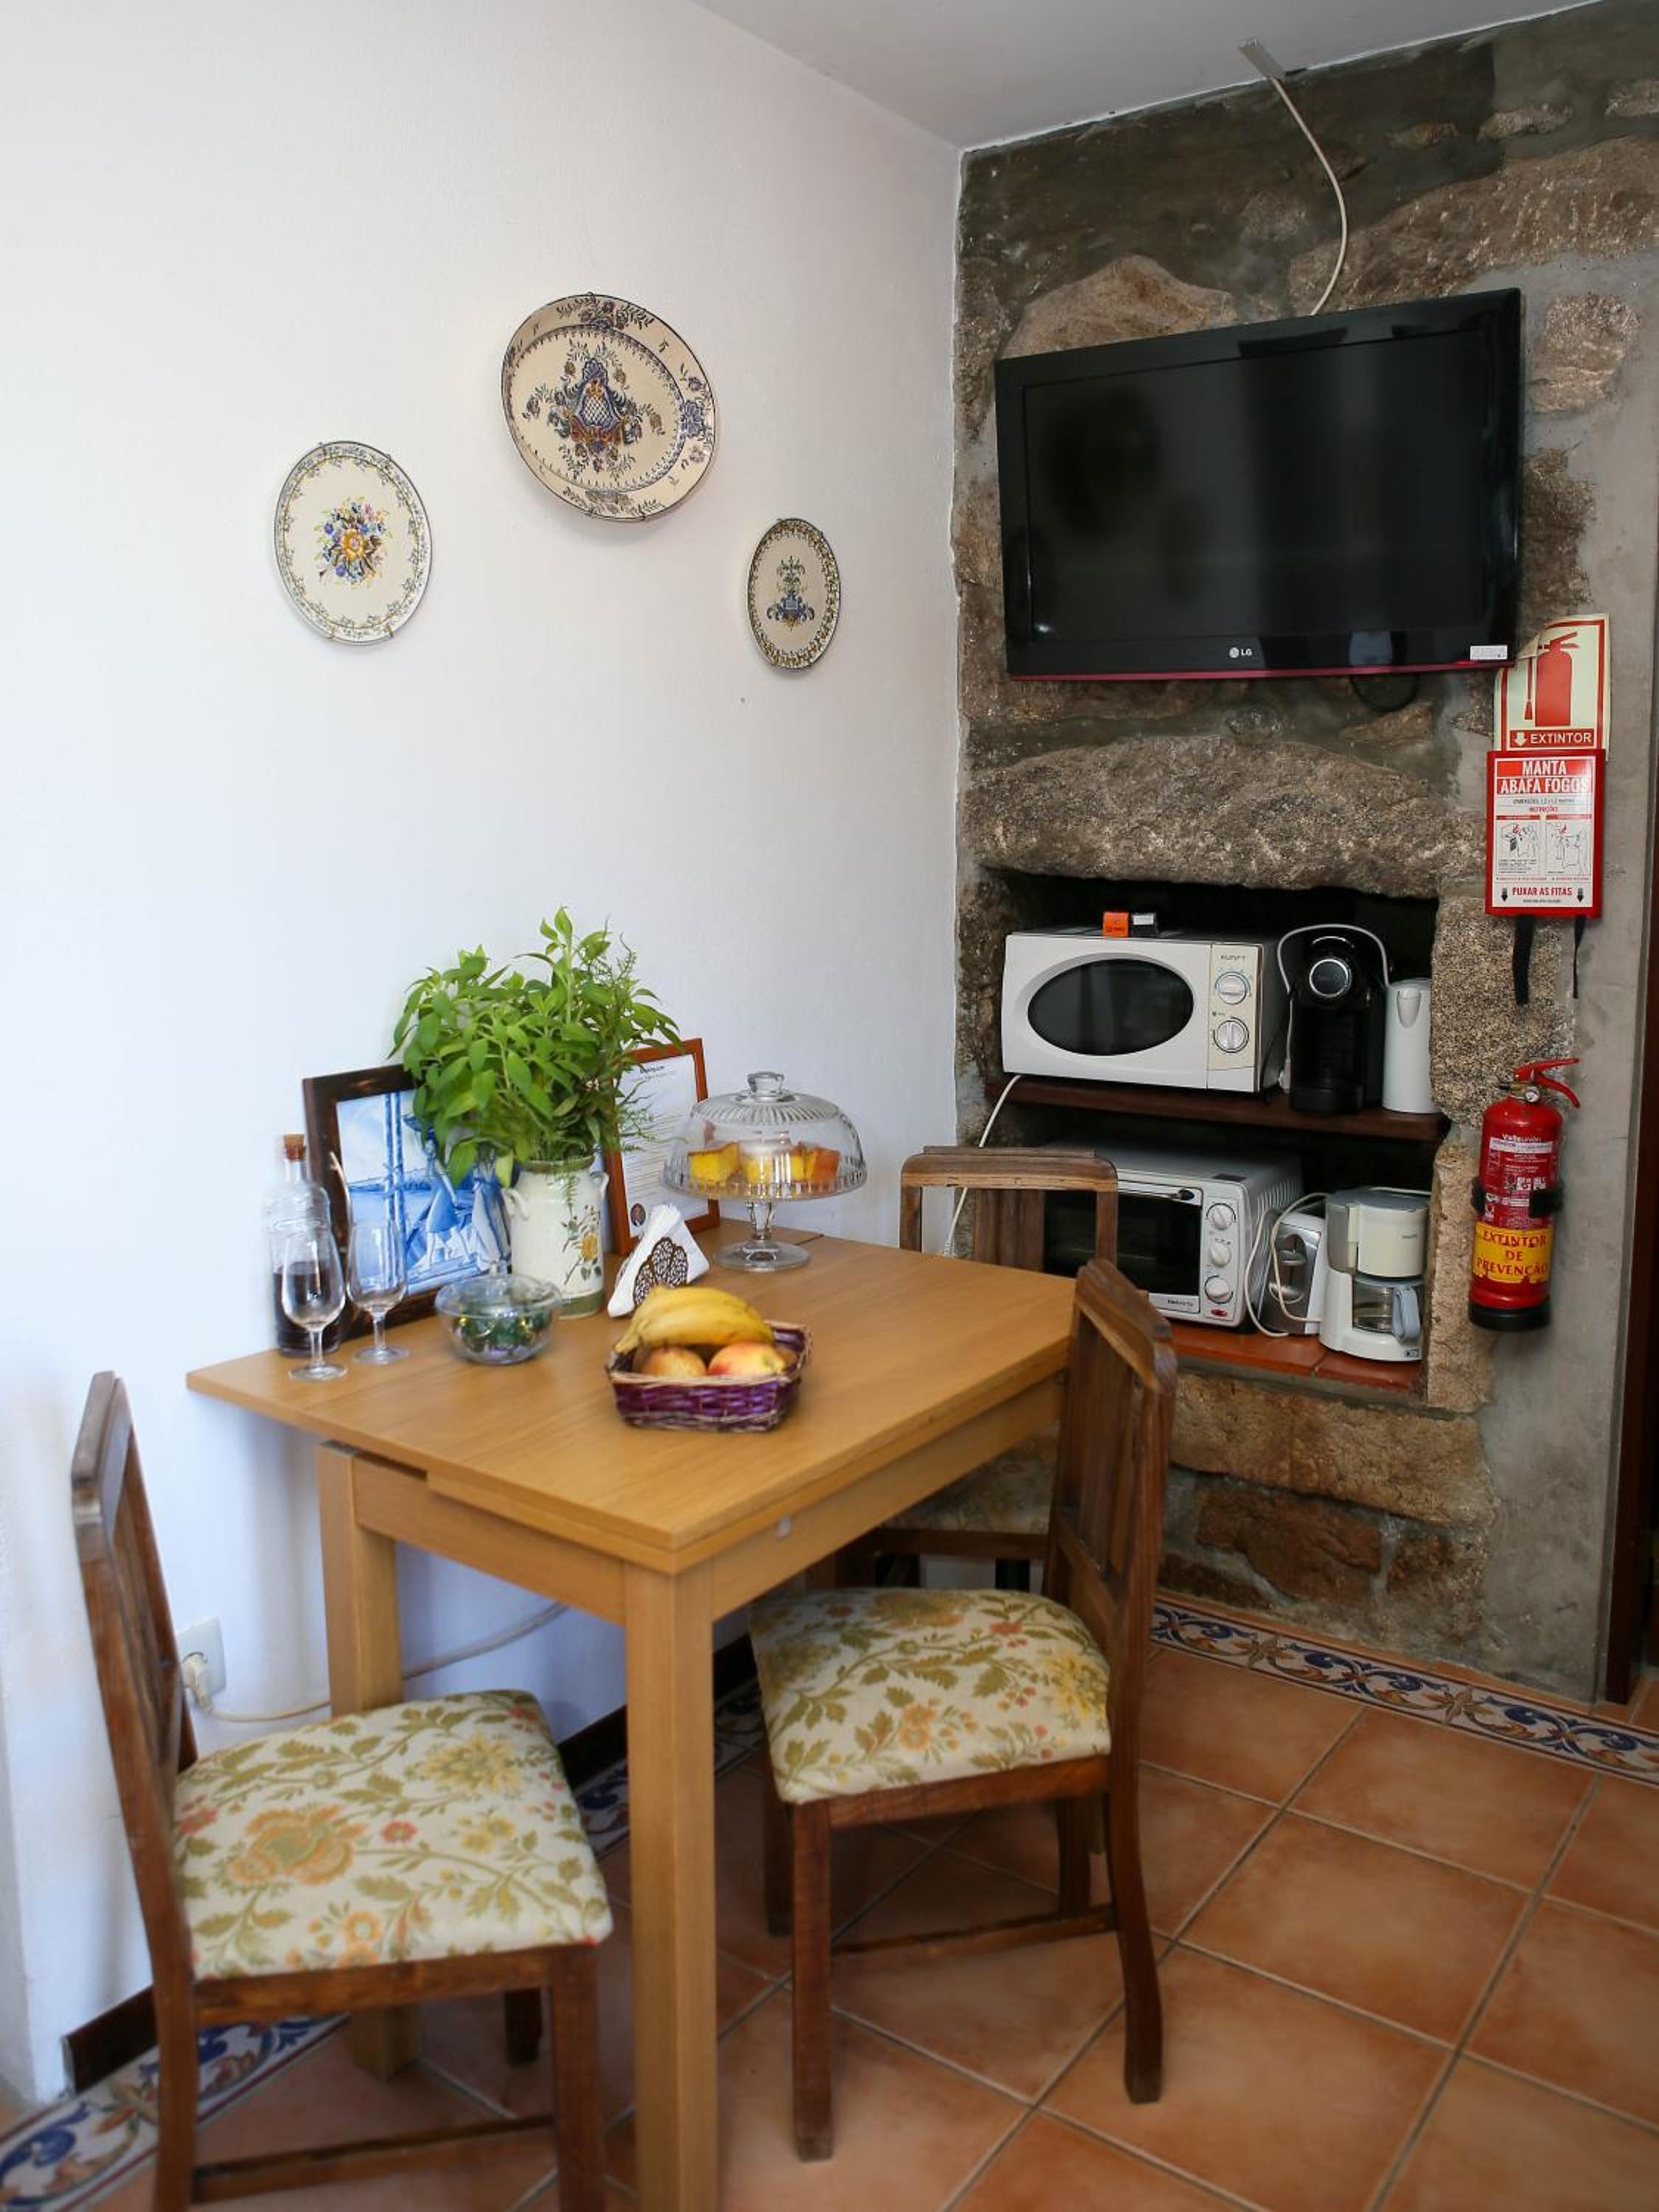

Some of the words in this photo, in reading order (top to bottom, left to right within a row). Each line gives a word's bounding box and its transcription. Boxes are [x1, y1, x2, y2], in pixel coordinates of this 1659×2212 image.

[1241, 648, 1253, 656] LG
[1530, 732, 1592, 744] EXTINTOR
[1522, 760, 1567, 776] MANTA
[1500, 778, 1542, 794] ABAFA
[1545, 778, 1589, 794] FOGOS
[1512, 887, 1537, 897] PUXAR
[1539, 887, 1549, 896] AS
[1551, 887, 1573, 896] FITAS
[1483, 1231, 1546, 1248] EXTINTOR
[1505, 1250, 1523, 1262] DE
[1477, 1257, 1548, 1276] PREVENÇÃO
